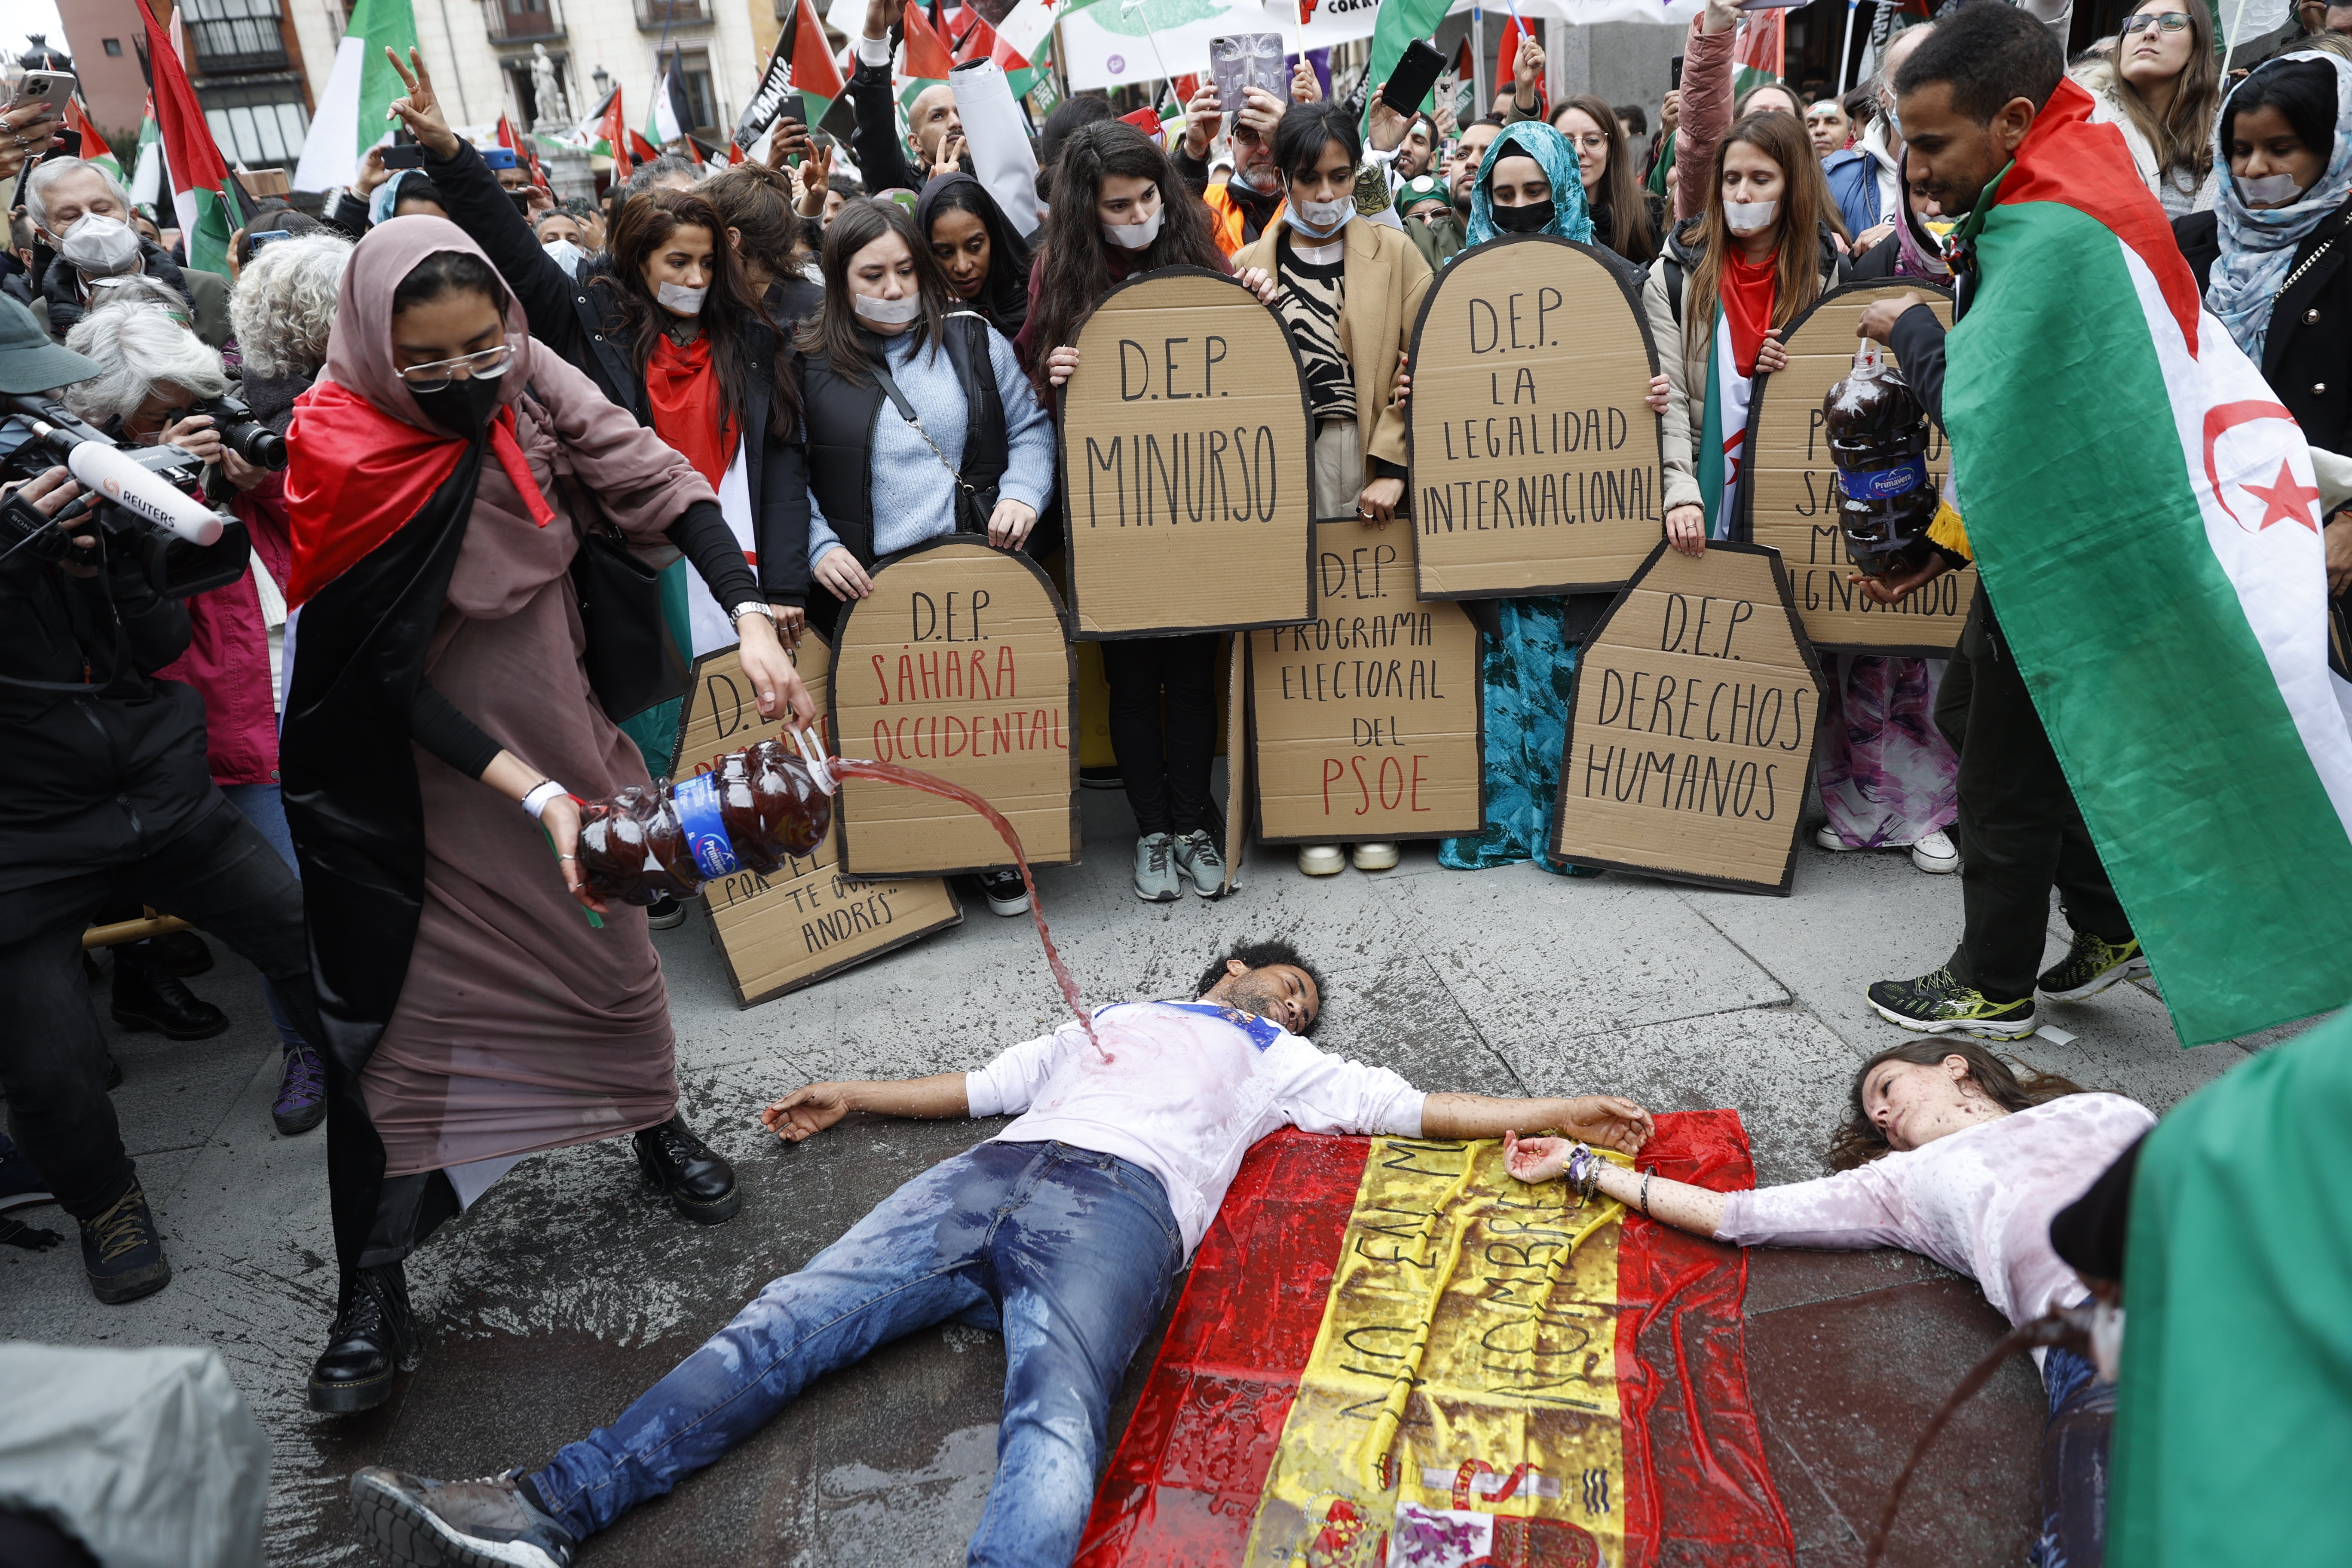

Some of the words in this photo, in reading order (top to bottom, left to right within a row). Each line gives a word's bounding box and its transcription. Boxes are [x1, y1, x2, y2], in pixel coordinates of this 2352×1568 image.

[1873, 2, 1892, 44] HARA
[1032, 79, 1056, 110] BRE
[1469, 287, 1562, 353] D.E.P.
[1119, 335, 1228, 401] D.E.P.
[1492, 368, 1536, 404] LA
[1444, 407, 1627, 460] LEGALIDAD
[1086, 425, 1276, 528] MINURSO
[1423, 465, 1660, 535] INTERNACIONAL
[1875, 474, 1912, 489] Primavera
[123, 490, 175, 528] REUTERS
[1320, 544, 1396, 599] D.E.P.
[912, 589, 990, 643] D.E.P.
[1273, 612, 1432, 652] PROGRAMA
[1660, 593, 1753, 661] D.E.P.
[871, 645, 1015, 705] SÁHARA
[1282, 659, 1445, 702] ELECTORAL
[873, 708, 1068, 763] OCCIDENTAL
[1353, 715, 1406, 747] DEL
[1599, 668, 1809, 751] DERECHOS
[1323, 755, 1431, 816] PSOE
[1585, 744, 1778, 822] HUMANOS
[704, 840, 726, 874] Primavera
[784, 883, 821, 914] TE
[1382, 1141, 1468, 1177] M
[1355, 1207, 1445, 1268] EN
[1481, 1191, 1600, 1410] NOMBRE
